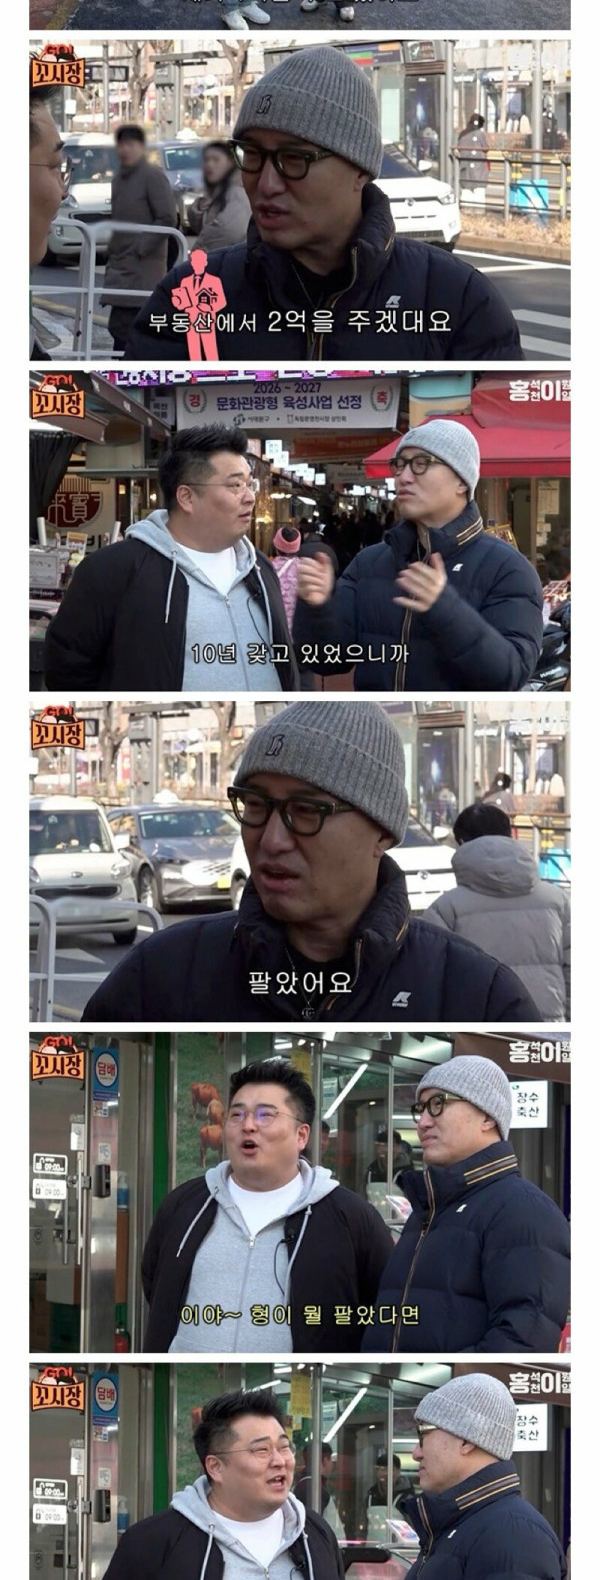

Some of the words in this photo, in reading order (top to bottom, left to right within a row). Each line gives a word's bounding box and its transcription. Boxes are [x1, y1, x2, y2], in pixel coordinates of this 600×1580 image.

[253, 383, 281, 394] 2026
[294, 383, 322, 394] 2027
[216, 396, 278, 411] 문화관광형
[283, 396, 333, 410] 육성사업
[337, 396, 362, 410] 선정
[97, 1061, 116, 1076] 담배
[517, 1092, 539, 1103] 장수
[97, 1387, 115, 1401] 담배
[517, 1415, 538, 1427] 장수
